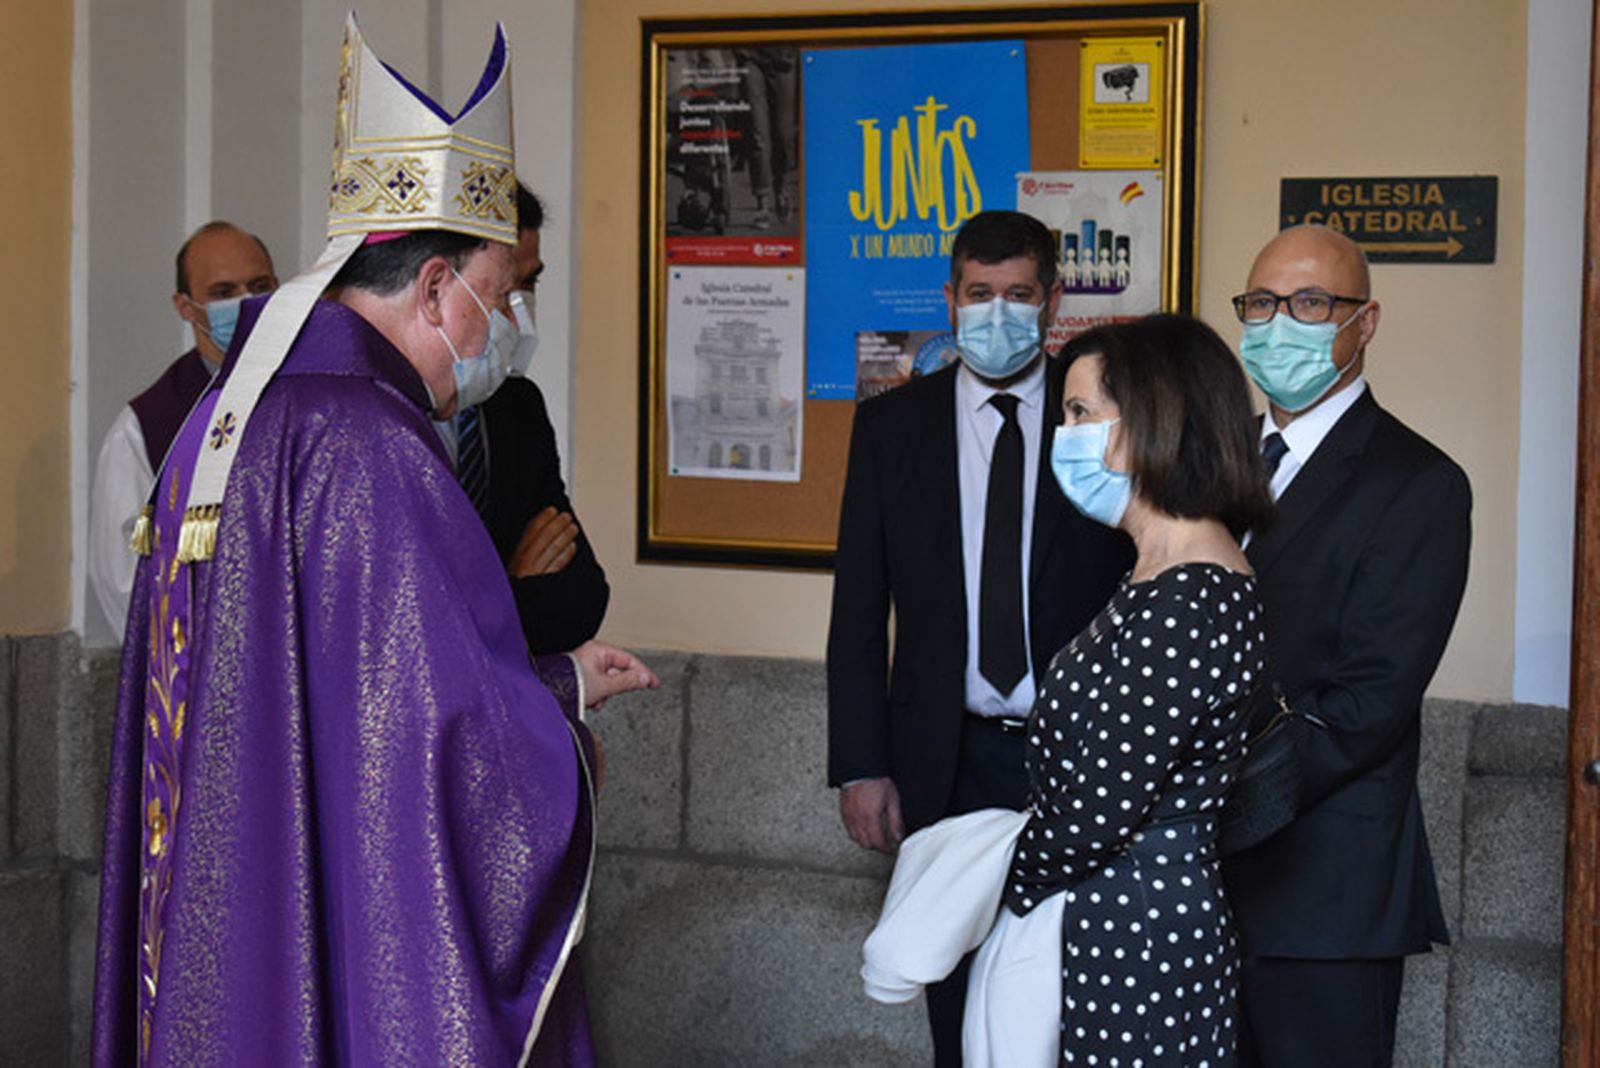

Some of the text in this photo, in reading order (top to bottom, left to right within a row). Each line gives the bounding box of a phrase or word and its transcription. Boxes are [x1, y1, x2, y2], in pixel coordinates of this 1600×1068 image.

[849, 96, 982, 231] JUNTOS
[1321, 184, 1444, 206] IGLESIA
[1304, 210, 1468, 232] CATEDRAL
[850, 234, 861, 257] X
[865, 234, 884, 258] UN
[888, 233, 934, 258] MUNDO
